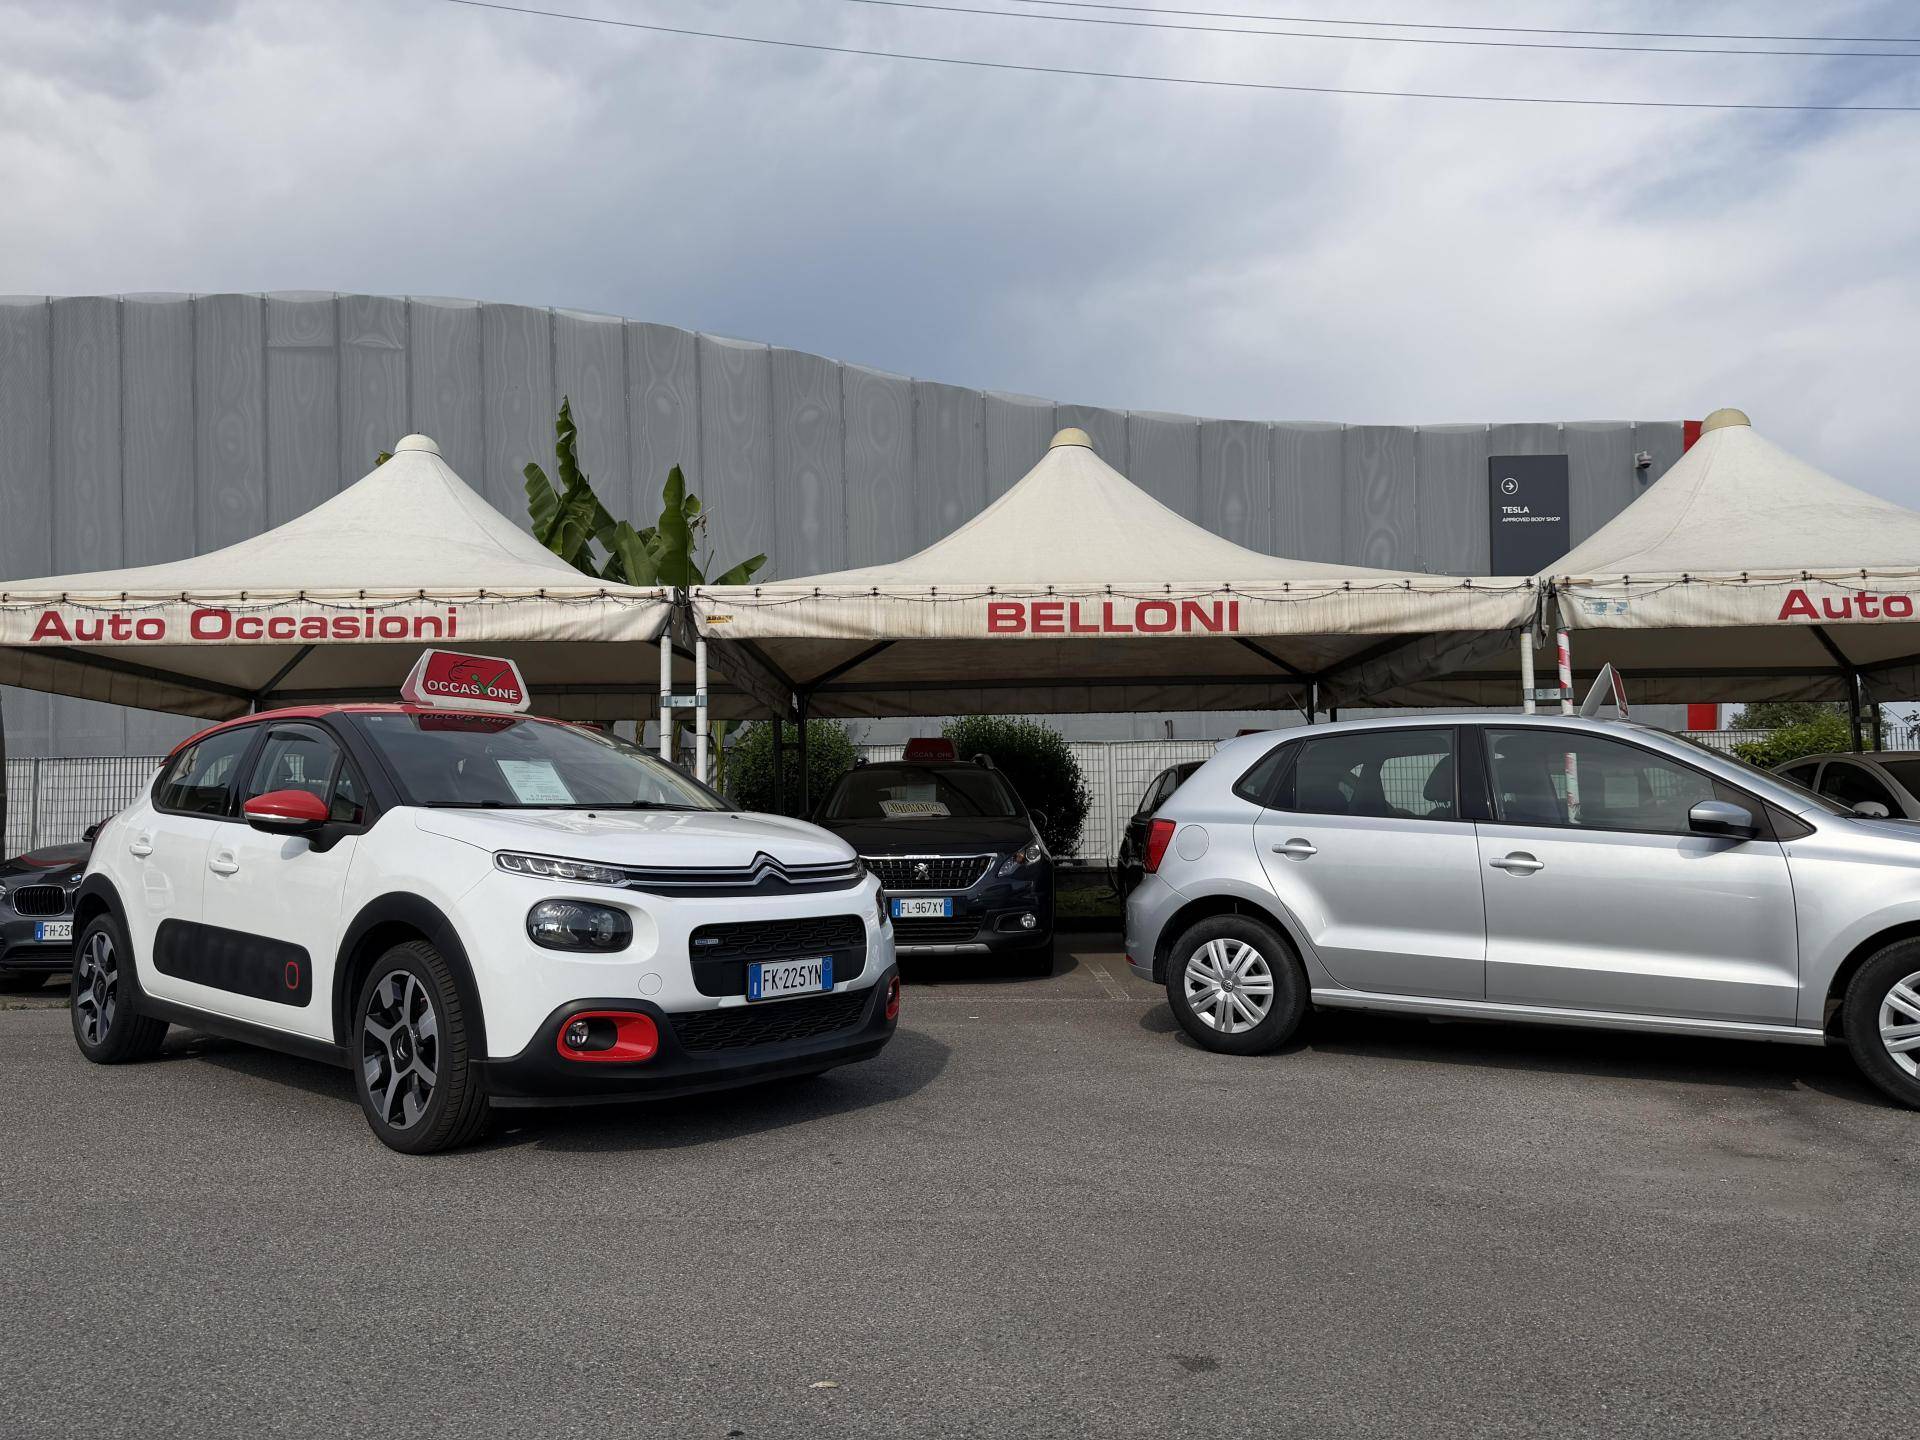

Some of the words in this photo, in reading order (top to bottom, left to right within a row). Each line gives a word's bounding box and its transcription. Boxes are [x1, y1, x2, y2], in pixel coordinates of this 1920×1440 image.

[1501, 506, 1530, 514] TESLA
[987, 600, 1239, 633] BELLONI
[1777, 589, 1914, 620] Auto
[29, 610, 166, 641] Auto
[190, 606, 457, 640] Occasioni
